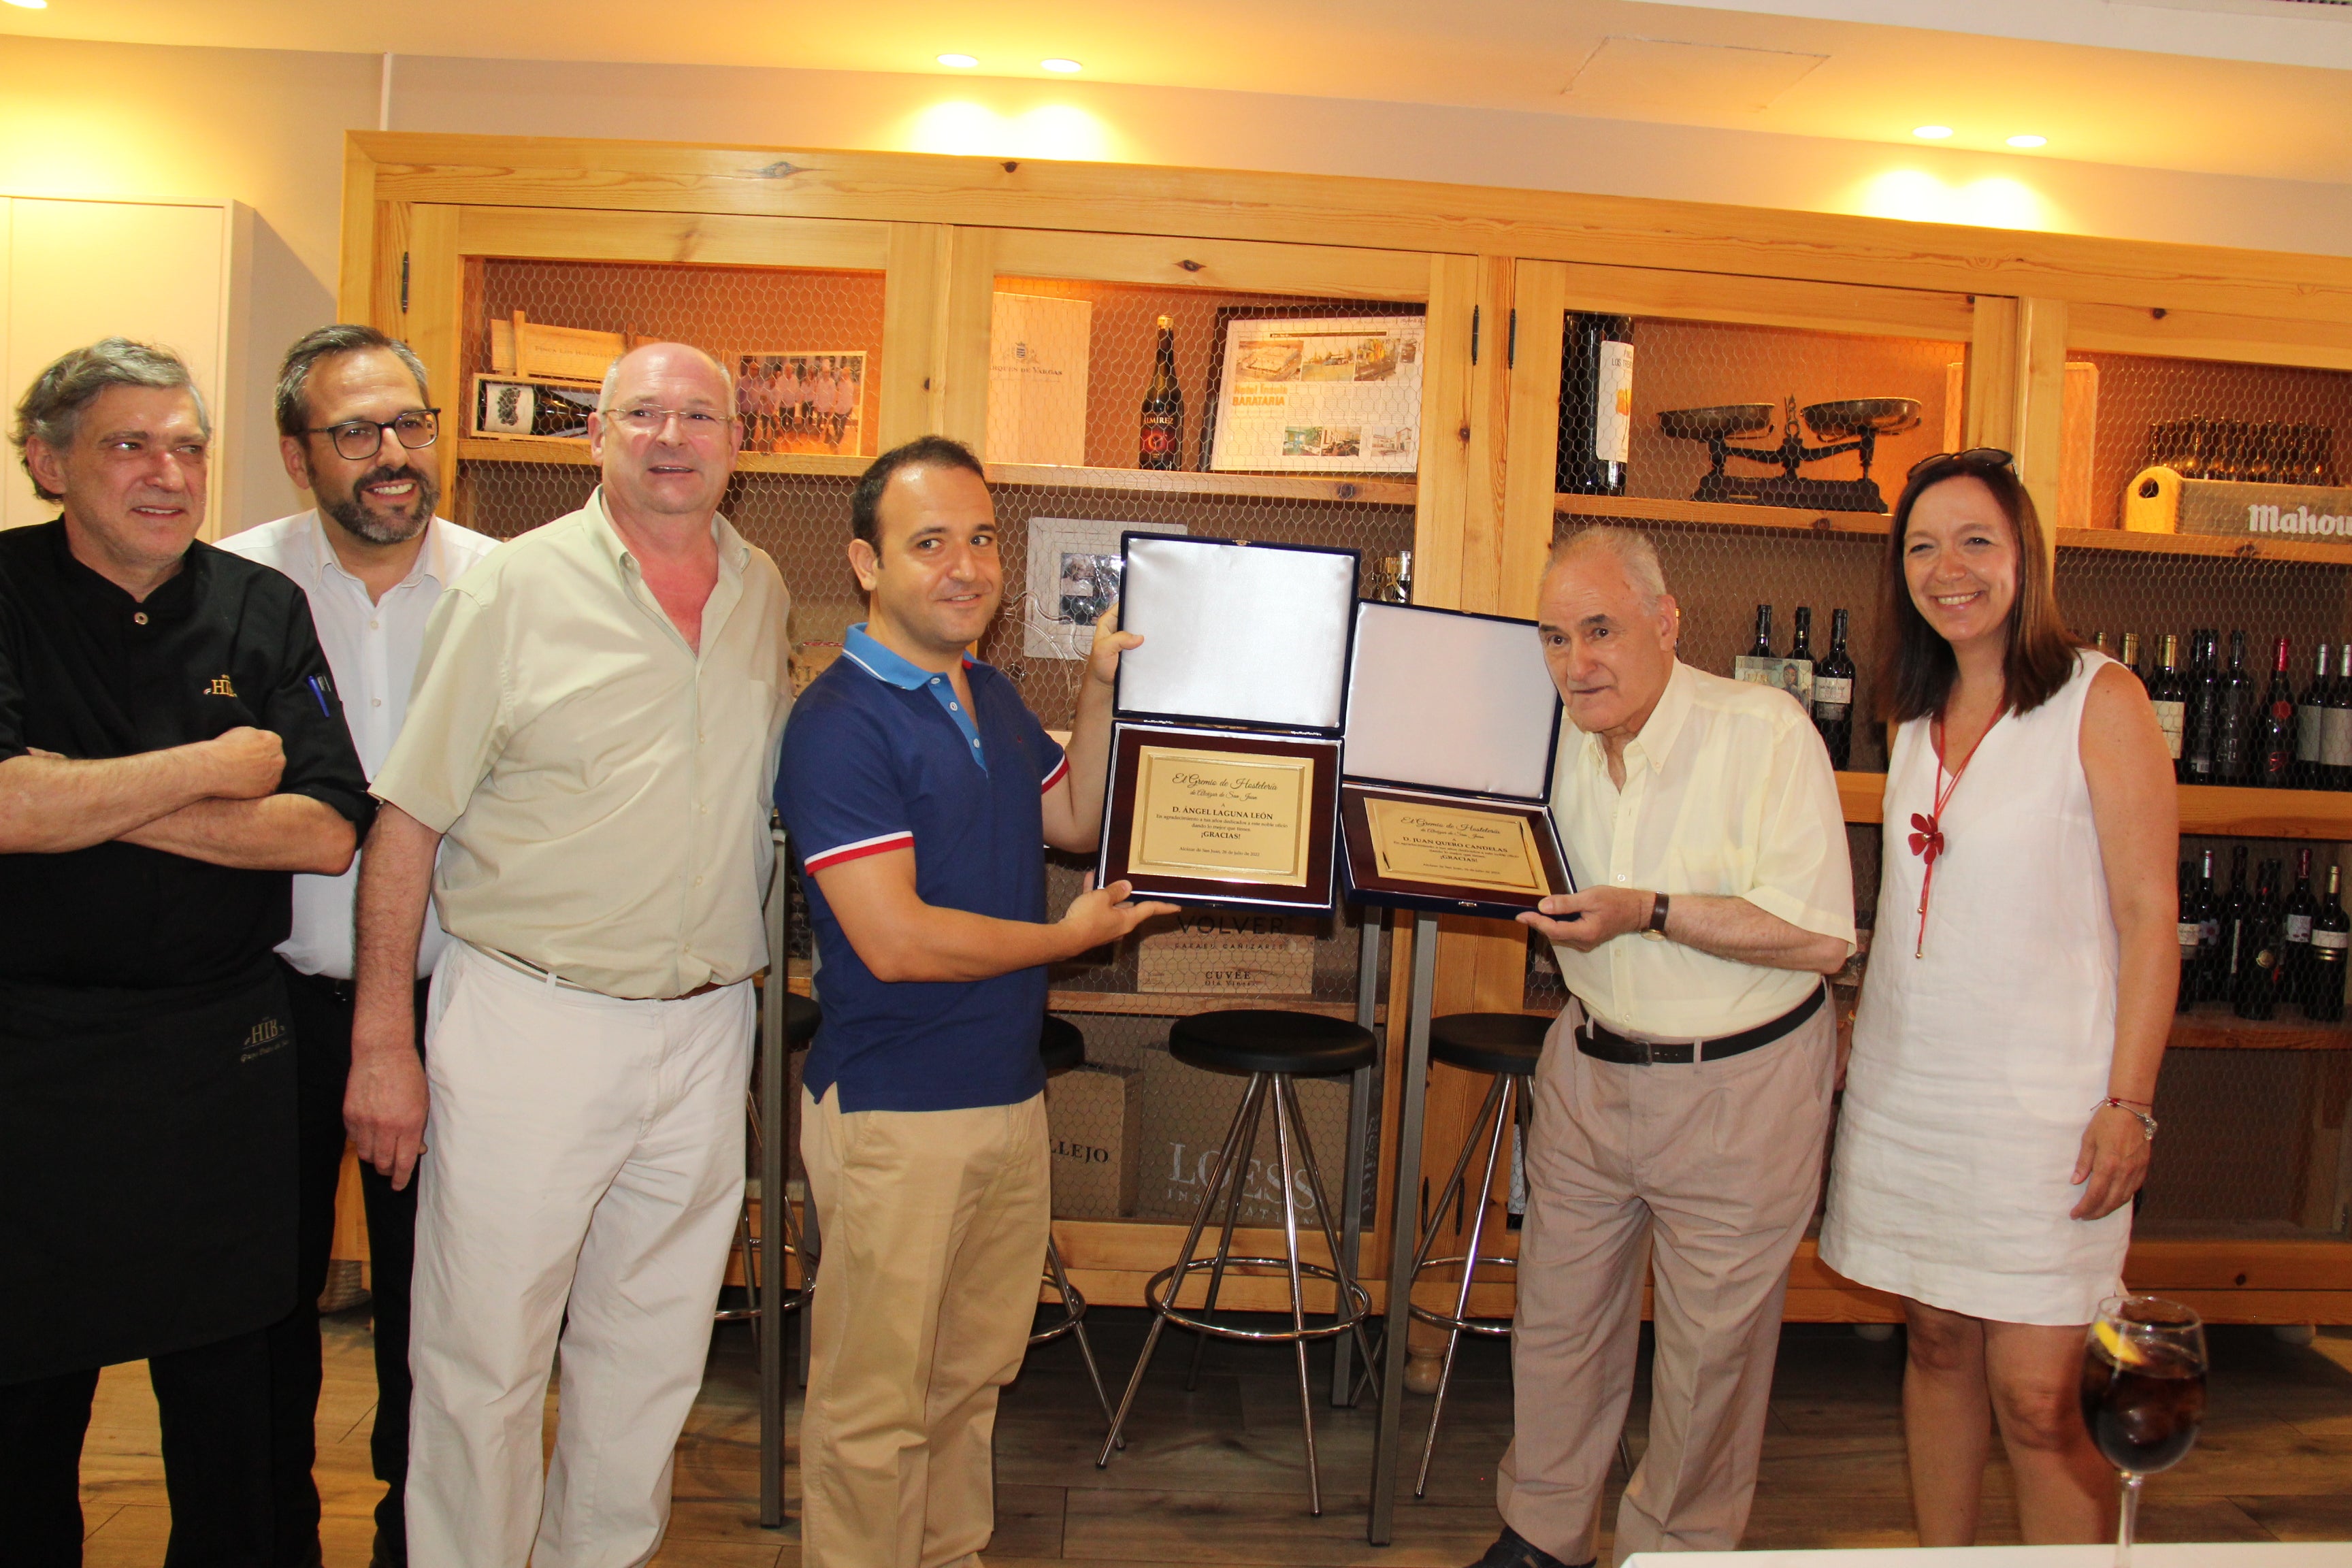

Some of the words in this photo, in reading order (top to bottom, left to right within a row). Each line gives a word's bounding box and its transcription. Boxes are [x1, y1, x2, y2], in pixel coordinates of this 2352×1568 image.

[1033, 367, 1062, 375] VARGAS
[1232, 396, 1285, 406] BARATARIA
[2247, 504, 2352, 536] Mahou
[1172, 772, 1188, 784] El
[1187, 774, 1217, 788] Gremio
[1219, 778, 1228, 787] de
[1230, 778, 1278, 790] Hostelería
[1183, 805, 1211, 815] ÁNGEL
[1213, 808, 1248, 818] LAGUNA
[1251, 811, 1273, 820] LEÓN
[1416, 818, 1443, 827] Gremio
[1200, 830, 1241, 839] ¡GRACIAS!
[1465, 844, 1507, 853] CANDELAS
[1178, 915, 1285, 934] VOLVER
[1222, 943, 1284, 951] CAÑIZARES
[1205, 969, 1252, 980] CUVÉE
